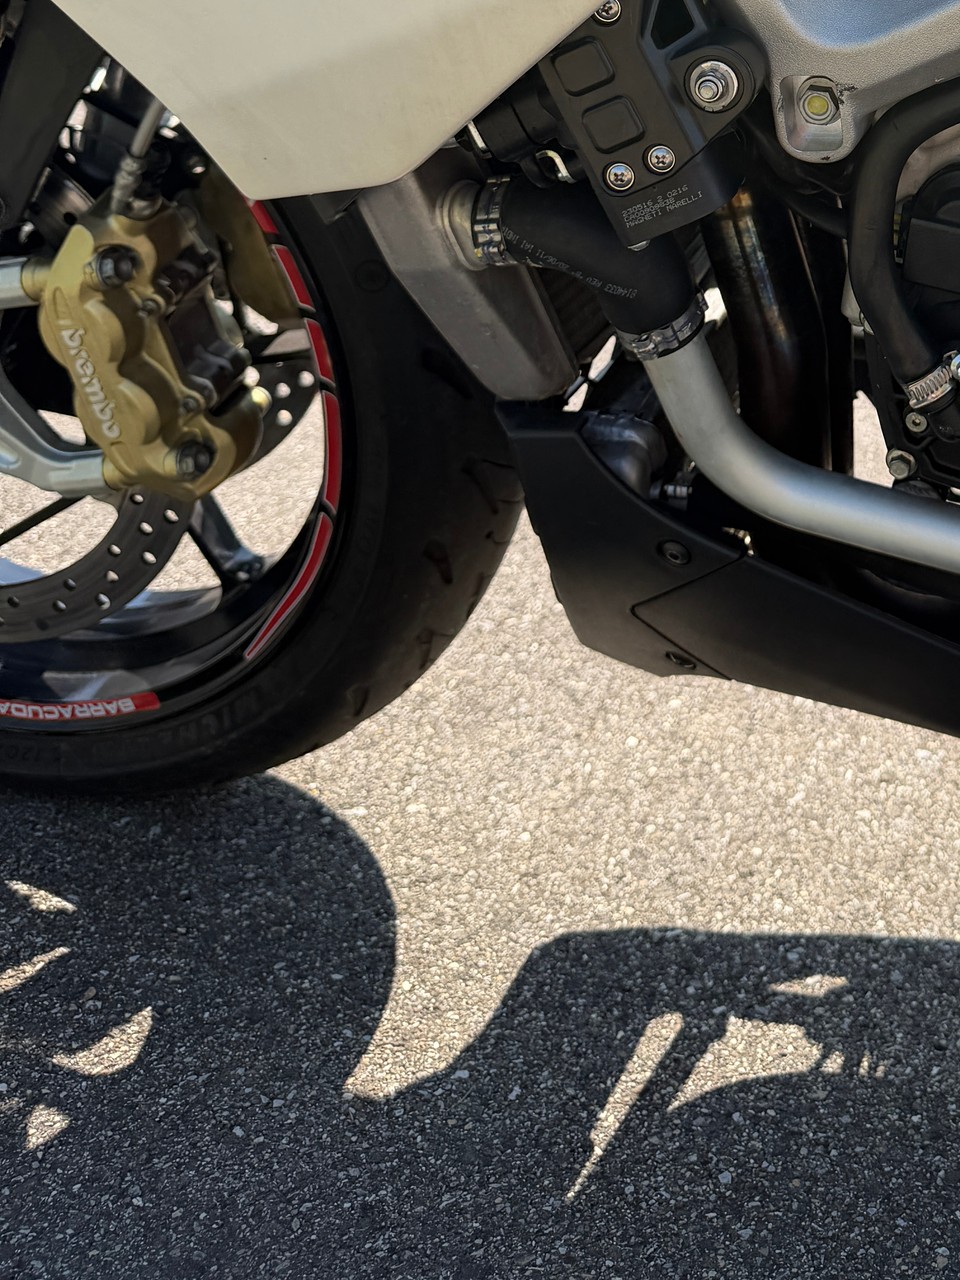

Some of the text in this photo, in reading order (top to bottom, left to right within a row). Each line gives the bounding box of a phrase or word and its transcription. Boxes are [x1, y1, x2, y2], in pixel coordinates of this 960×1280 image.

[626, 191, 703, 228] MAGNETI MARELLI
[60, 327, 122, 439] brembo
[0, 696, 136, 720] BARRACUDA
